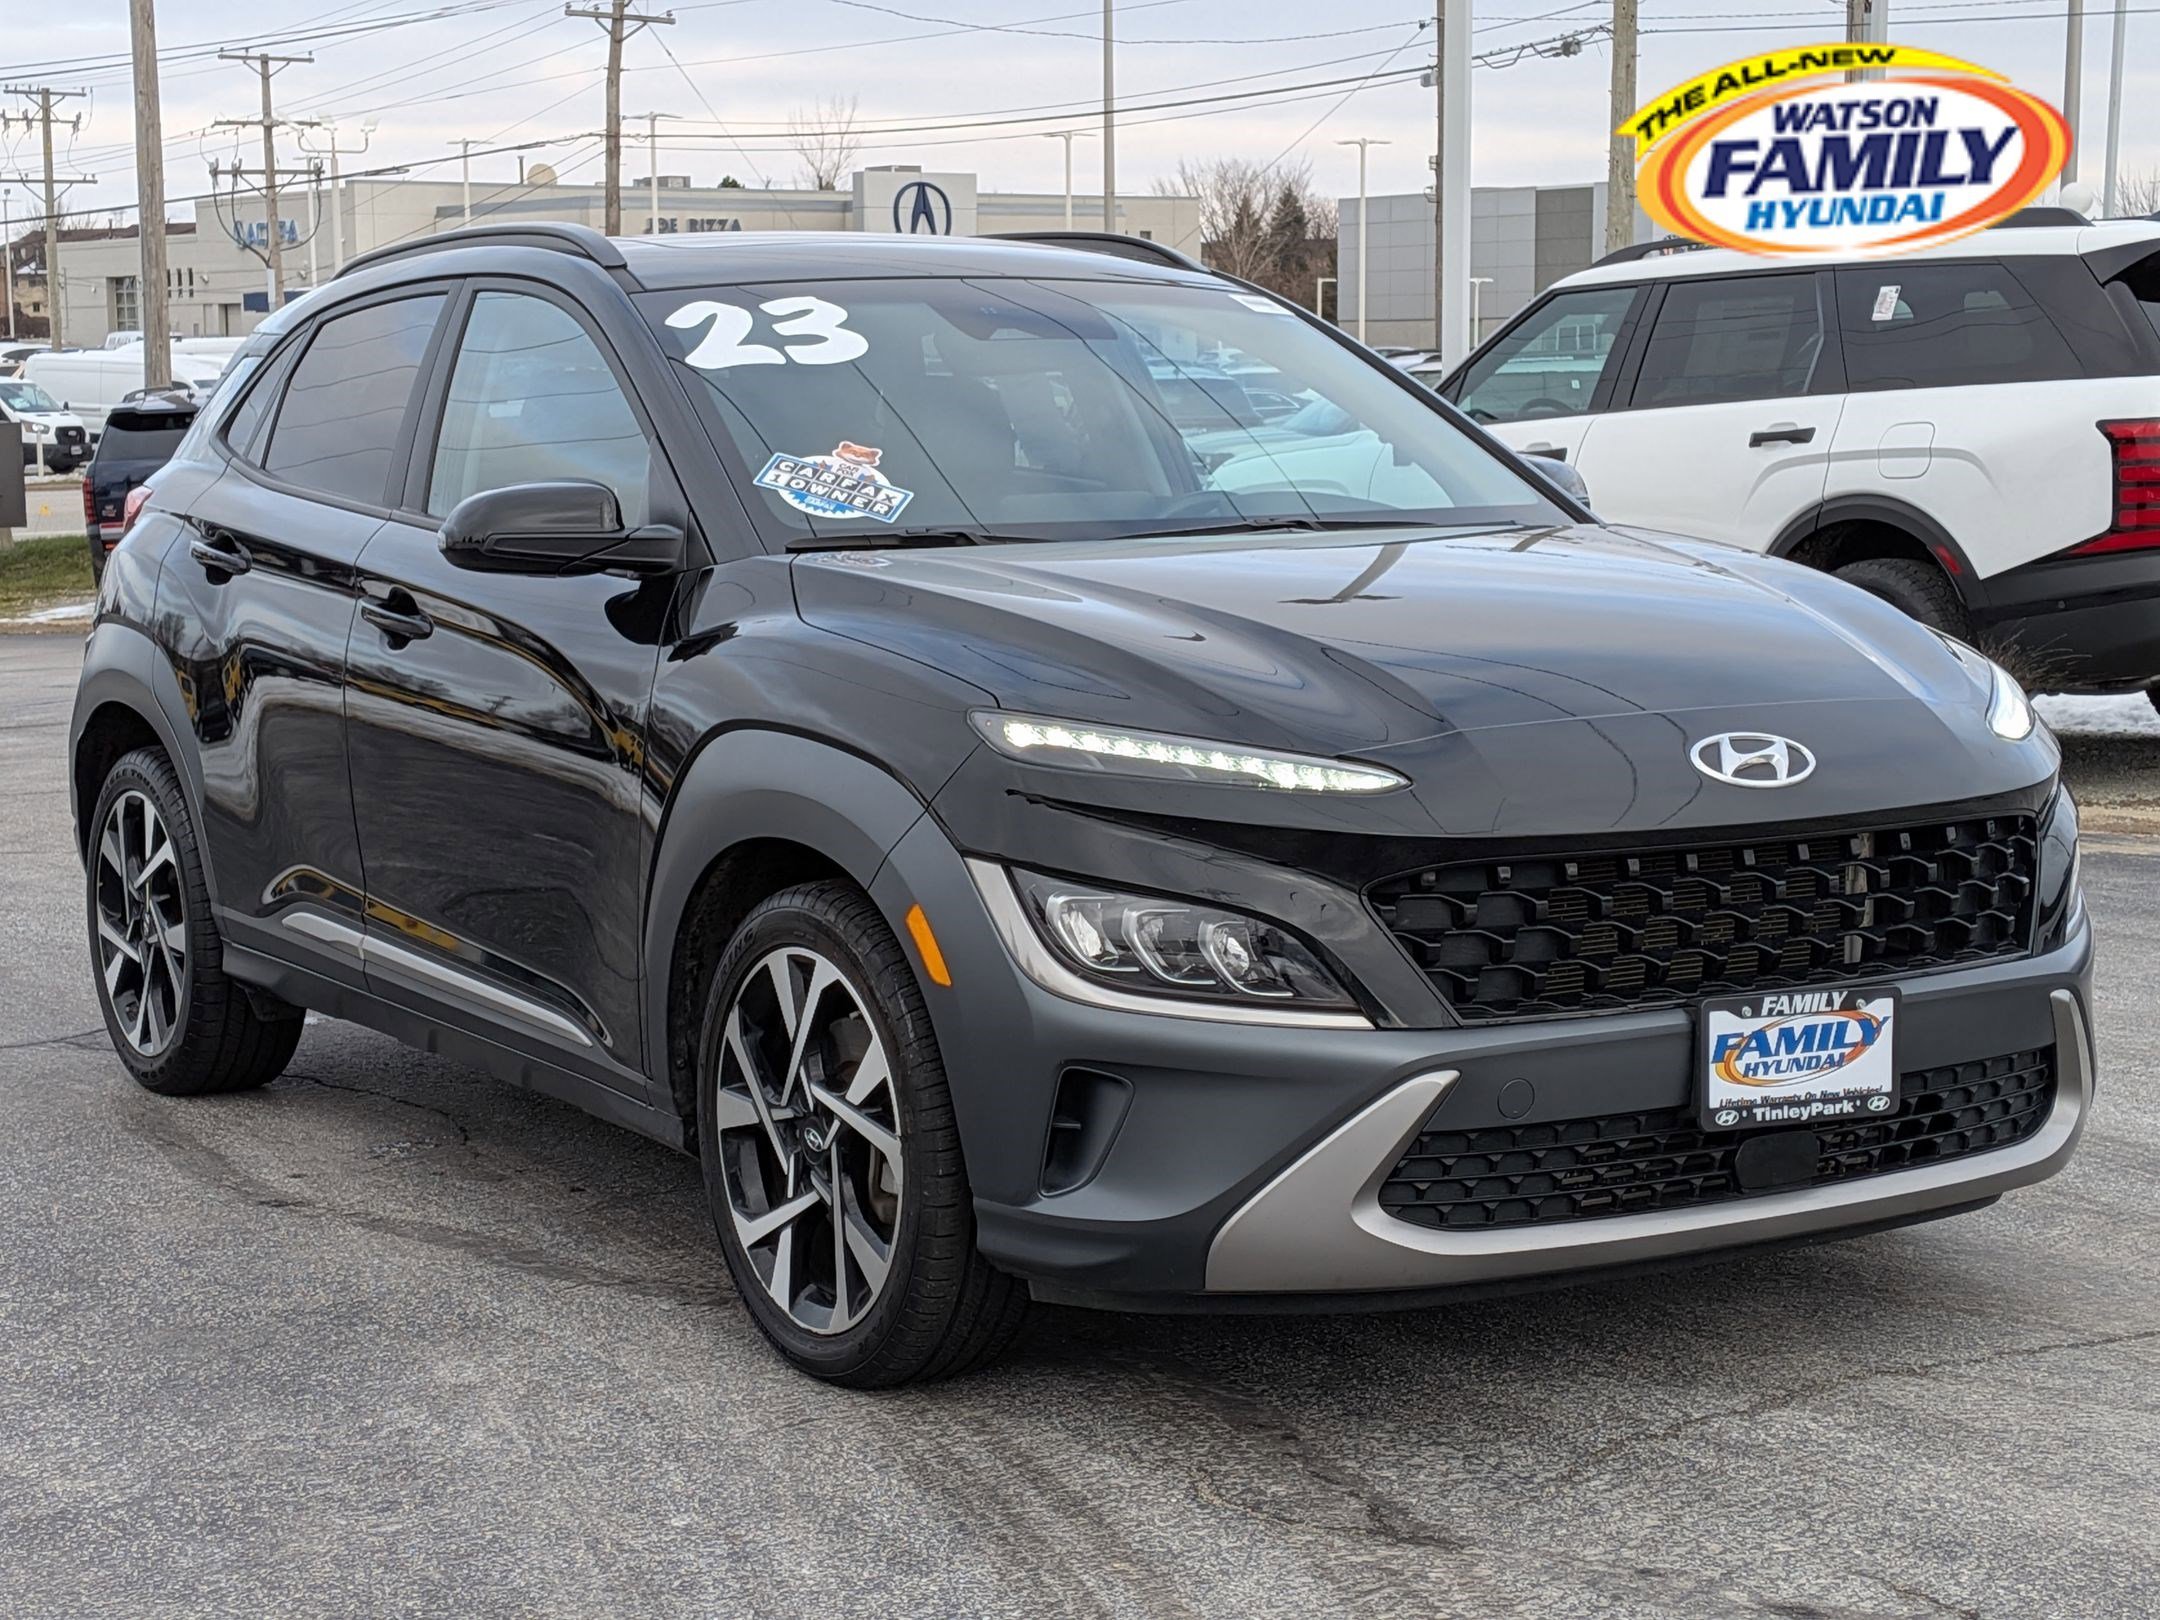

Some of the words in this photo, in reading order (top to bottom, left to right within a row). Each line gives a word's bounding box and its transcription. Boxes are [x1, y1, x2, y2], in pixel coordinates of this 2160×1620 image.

[245, 219, 300, 246] ACRA
[643, 217, 678, 234] JOE
[686, 217, 743, 233] RIZZA
[664, 296, 870, 370] 23
[778, 461, 899, 506] CARFAX
[788, 479, 889, 515] OWNER
[1760, 991, 1848, 1016] FAMILY
[1711, 1015, 1892, 1064] FAMILY
[1743, 1053, 1847, 1078] HYUNDAI
[1752, 1099, 1855, 1122] TinleyPark
